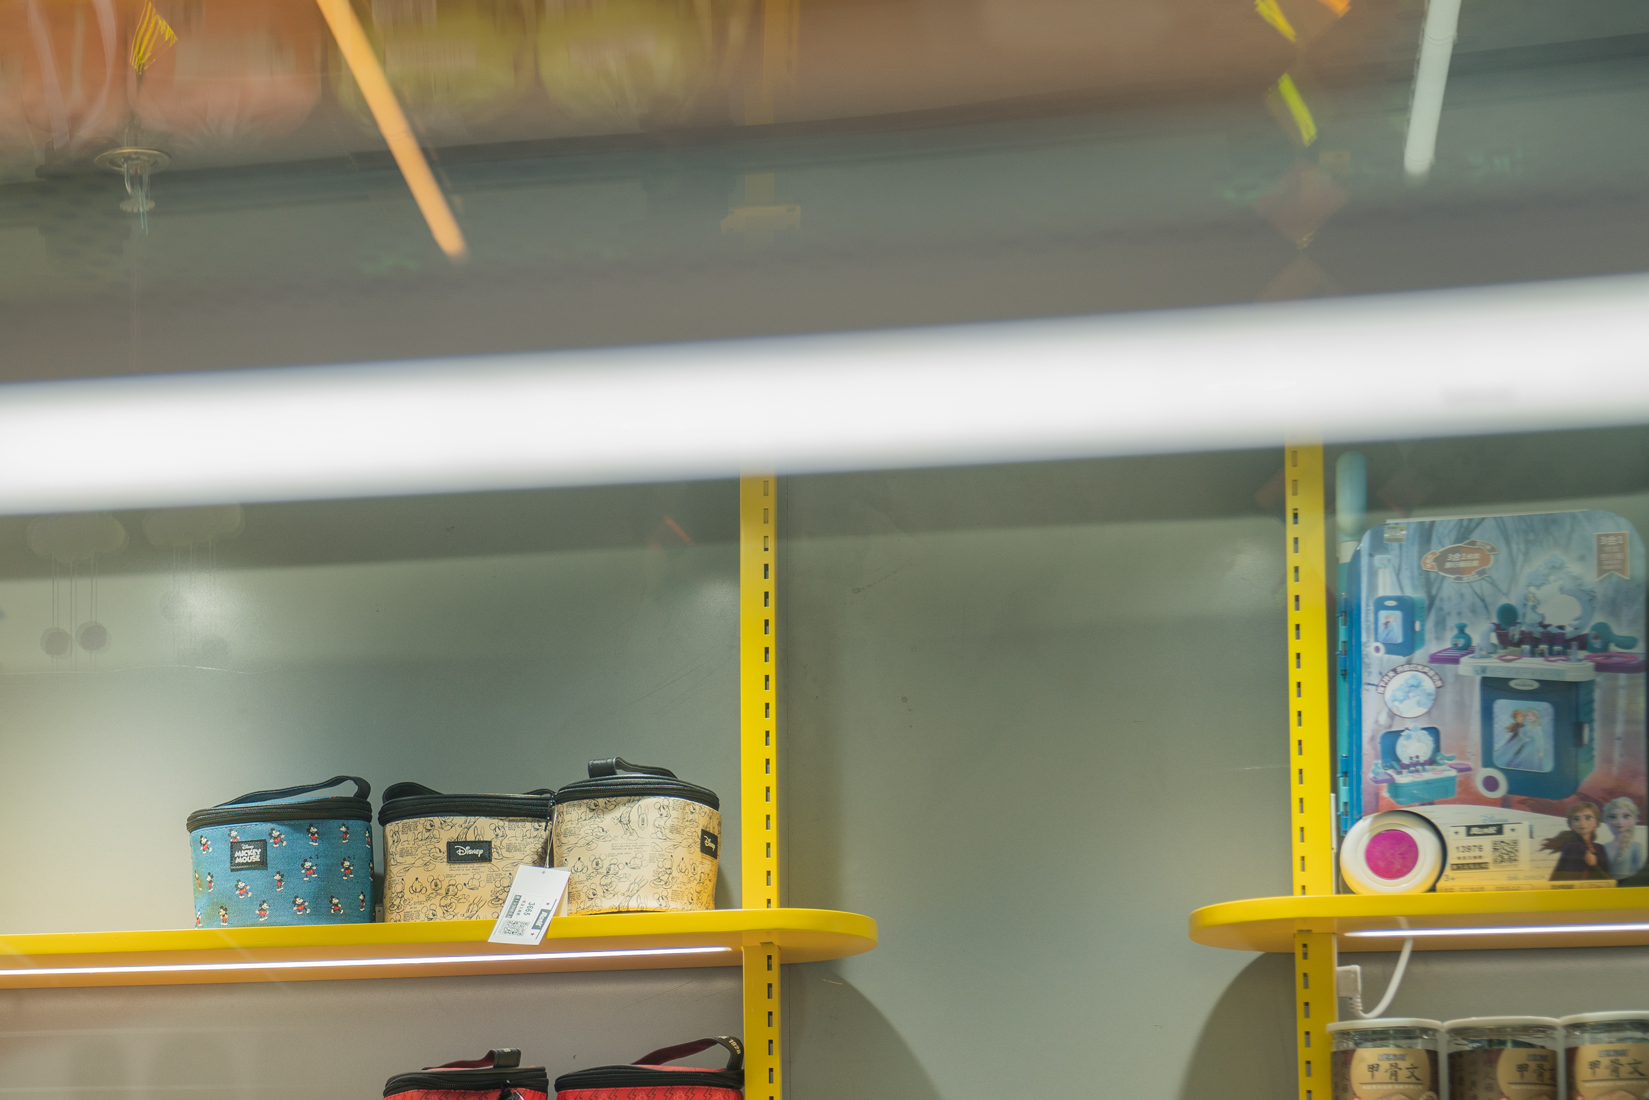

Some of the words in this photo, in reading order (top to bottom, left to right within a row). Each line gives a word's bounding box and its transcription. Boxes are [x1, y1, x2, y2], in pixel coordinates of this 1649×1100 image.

[234, 848, 262, 857] MICKEY
[454, 845, 484, 858] Disney
[235, 855, 261, 864] MOUSE
[523, 902, 536, 916] 3665
[1366, 1061, 1424, 1082] 甲骨文
[1587, 1058, 1649, 1079] 甲骨文
